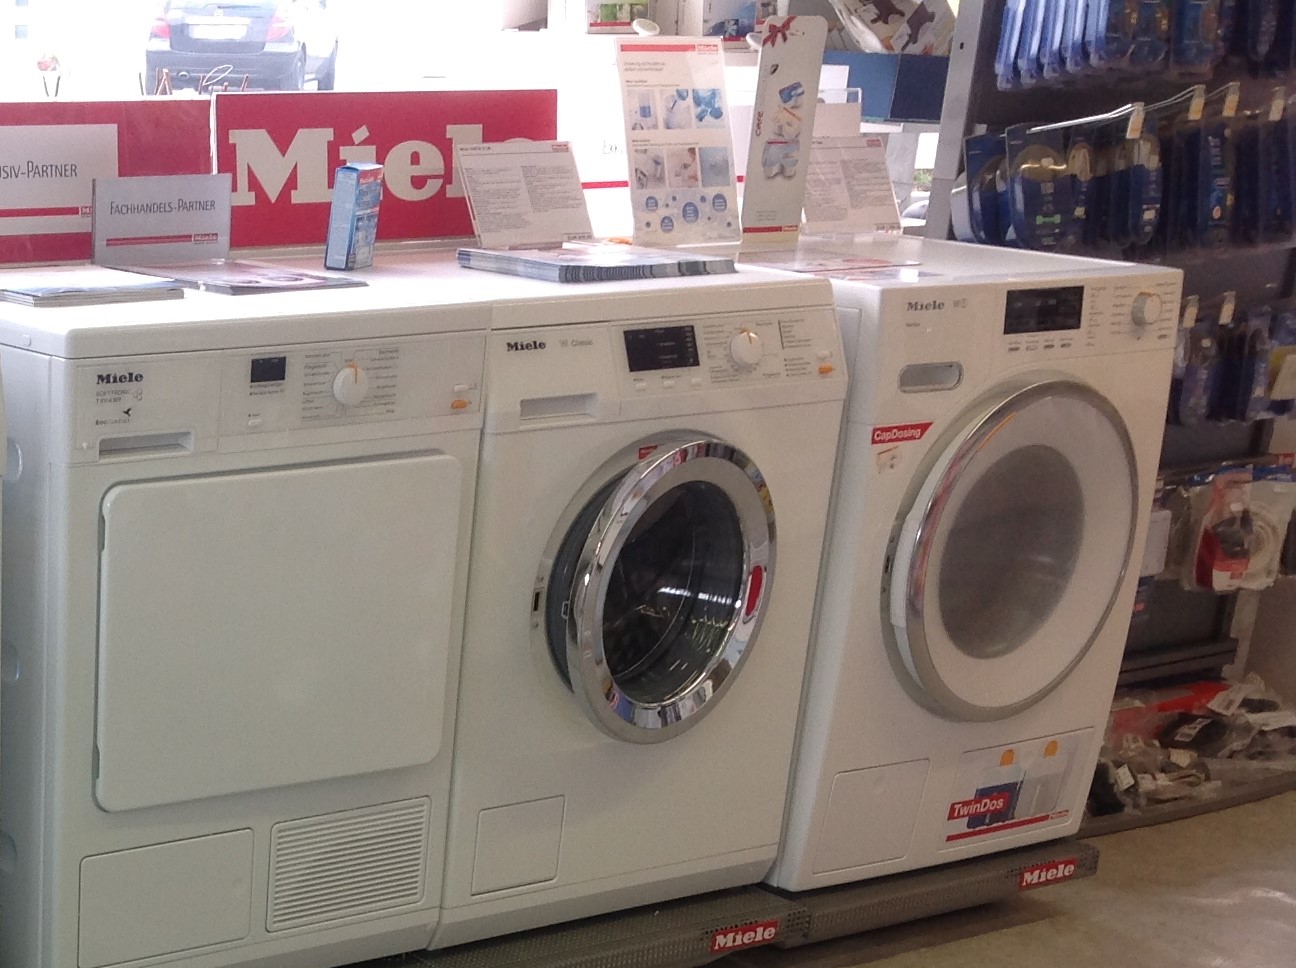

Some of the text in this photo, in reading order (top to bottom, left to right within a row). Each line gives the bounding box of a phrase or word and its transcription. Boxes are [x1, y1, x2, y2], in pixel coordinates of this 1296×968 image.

[228, 124, 536, 207] Miel
[907, 300, 945, 311] Miele
[506, 341, 546, 352] Miele
[96, 372, 144, 384] Miele
[874, 427, 922, 442] CapDosing
[953, 798, 1004, 817] TwinDos
[1022, 863, 1075, 887] Miele
[713, 924, 776, 951] Miele
